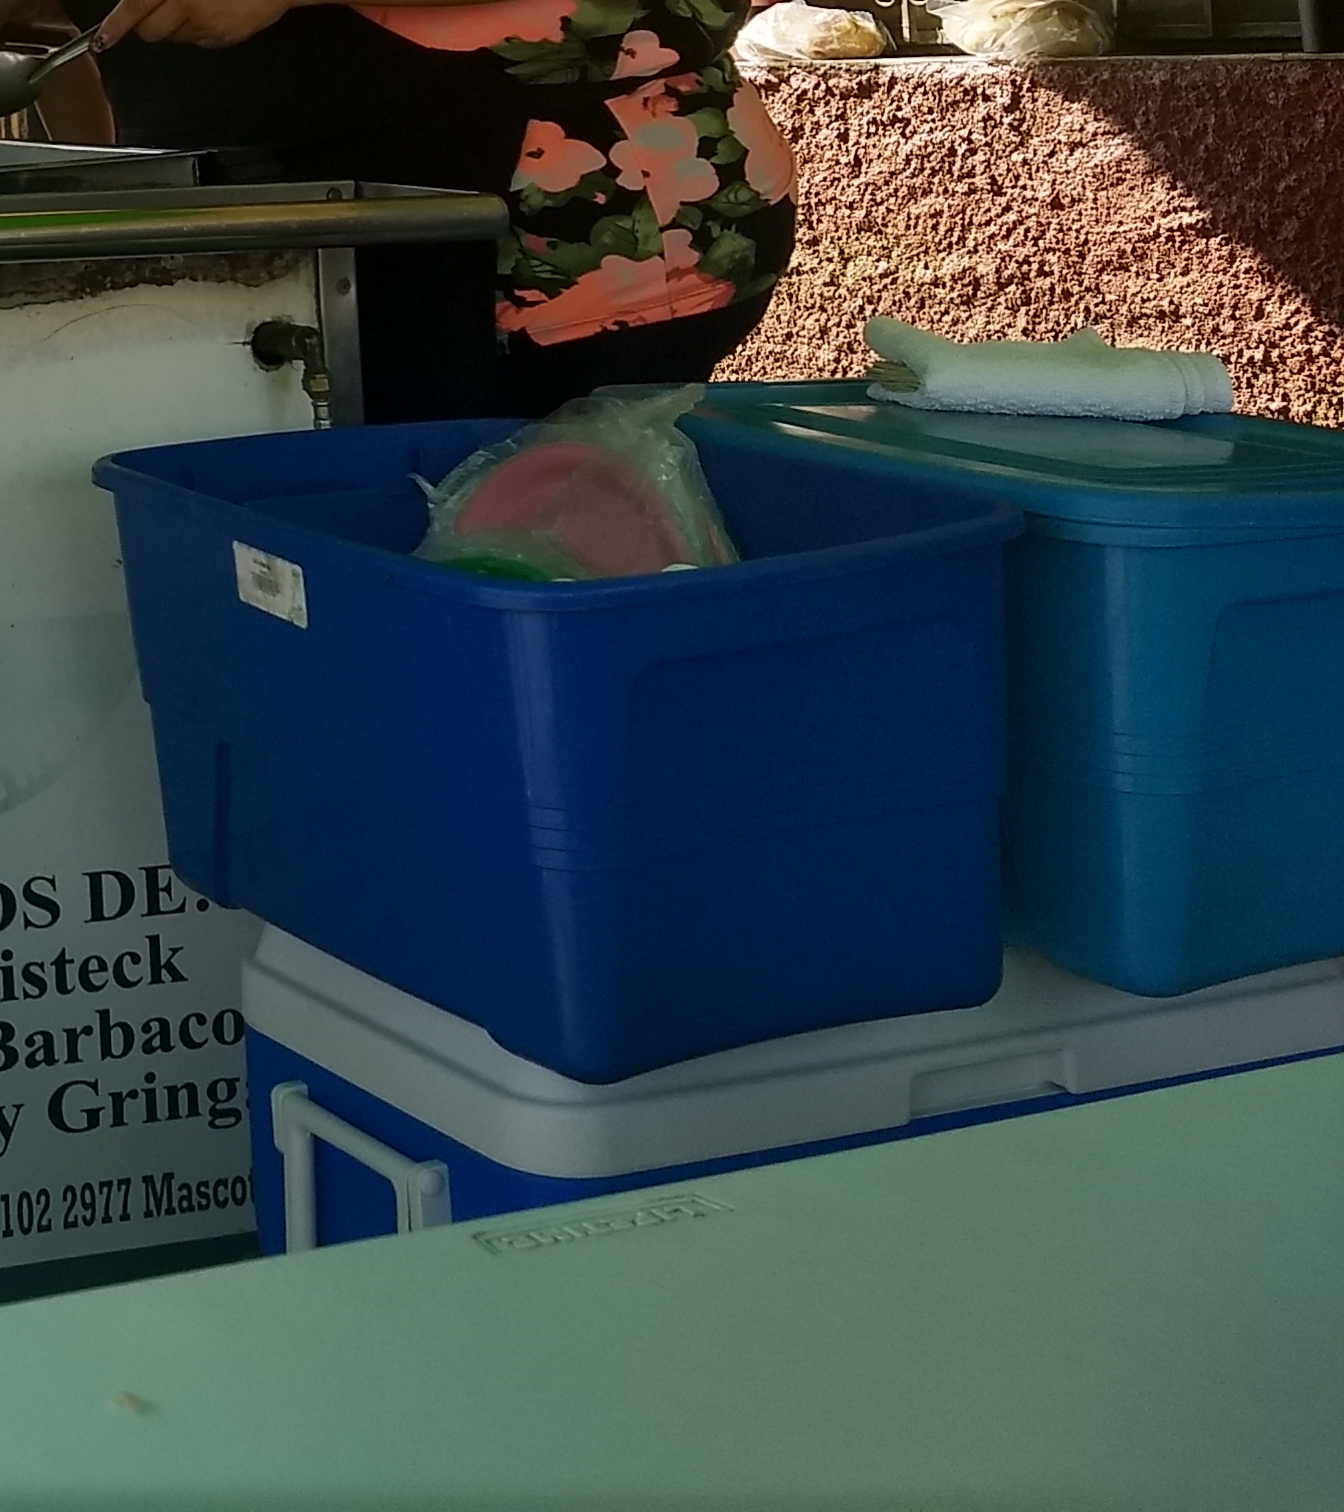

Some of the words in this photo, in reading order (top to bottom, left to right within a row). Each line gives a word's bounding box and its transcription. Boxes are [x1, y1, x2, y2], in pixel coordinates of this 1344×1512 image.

[48, 1071, 251, 1133] Gring
[1, 1188, 52, 1238] 102
[62, 1177, 131, 1229] 2977
